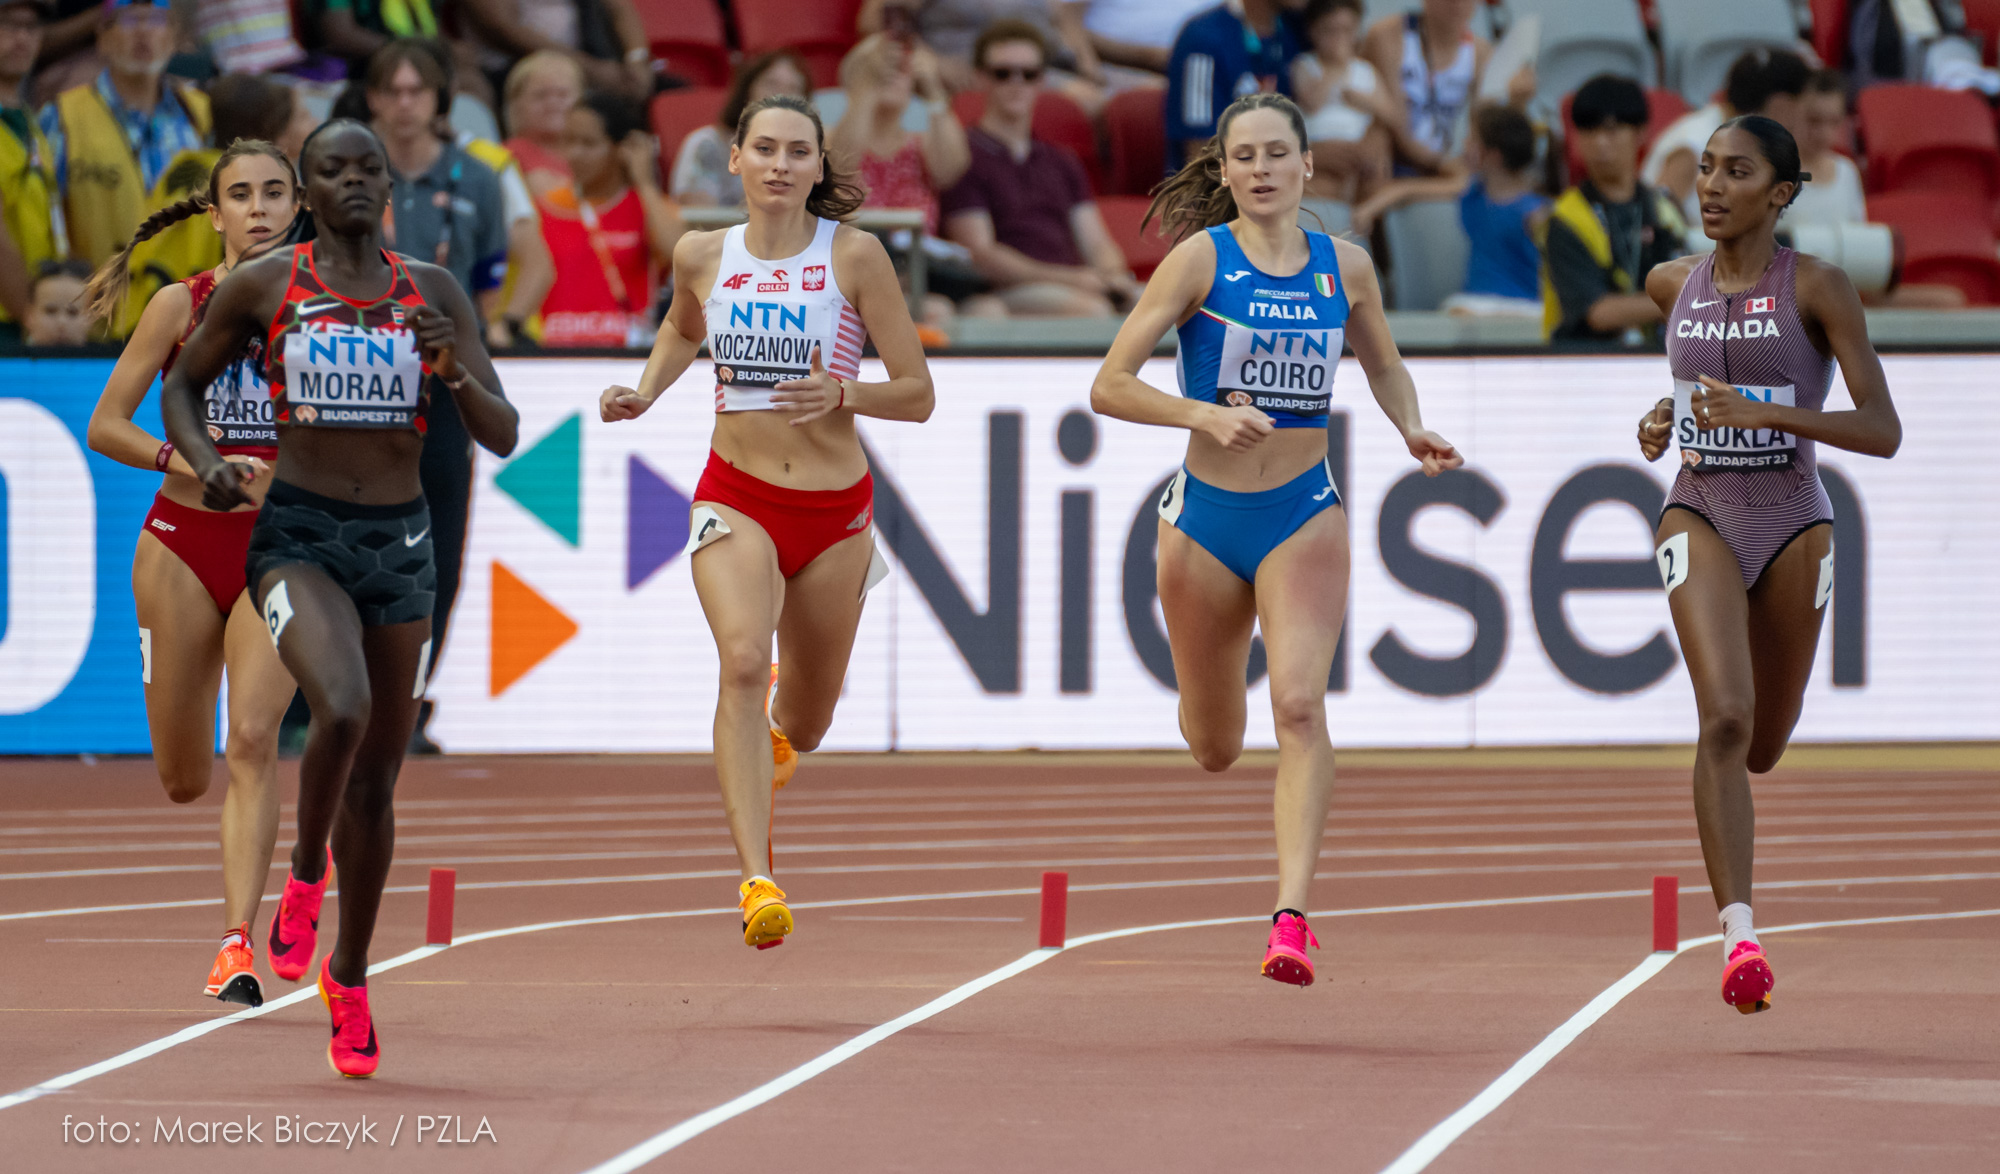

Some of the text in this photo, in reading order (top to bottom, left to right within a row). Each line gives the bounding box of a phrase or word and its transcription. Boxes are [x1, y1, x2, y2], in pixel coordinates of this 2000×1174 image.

[722, 273, 753, 290] 4F
[758, 283, 788, 292] ORLEN
[1254, 288, 1310, 298] FRECCIAROSSA
[730, 301, 806, 333] NTN
[1248, 302, 1318, 320] ITALIA
[1677, 318, 1781, 340] CANADA
[309, 336, 394, 367] NTN
[715, 333, 822, 364] KOCZANOWA
[1250, 331, 1328, 360] NTN
[736, 371, 804, 383] BUDAPEST
[1240, 359, 1326, 391] COIRO
[300, 371, 406, 401] MORAA
[1256, 396, 1318, 411] BUDAPEST
[321, 409, 408, 423] BUDAPEST 23
[228, 429, 278, 440] BUDAPE
[1679, 417, 1787, 449] SHUKLA
[1704, 454, 1788, 466] BUDAPEST 23
[151, 517, 177, 532] ESP
[1663, 547, 1676, 587] 2
[267, 601, 279, 636] 6
